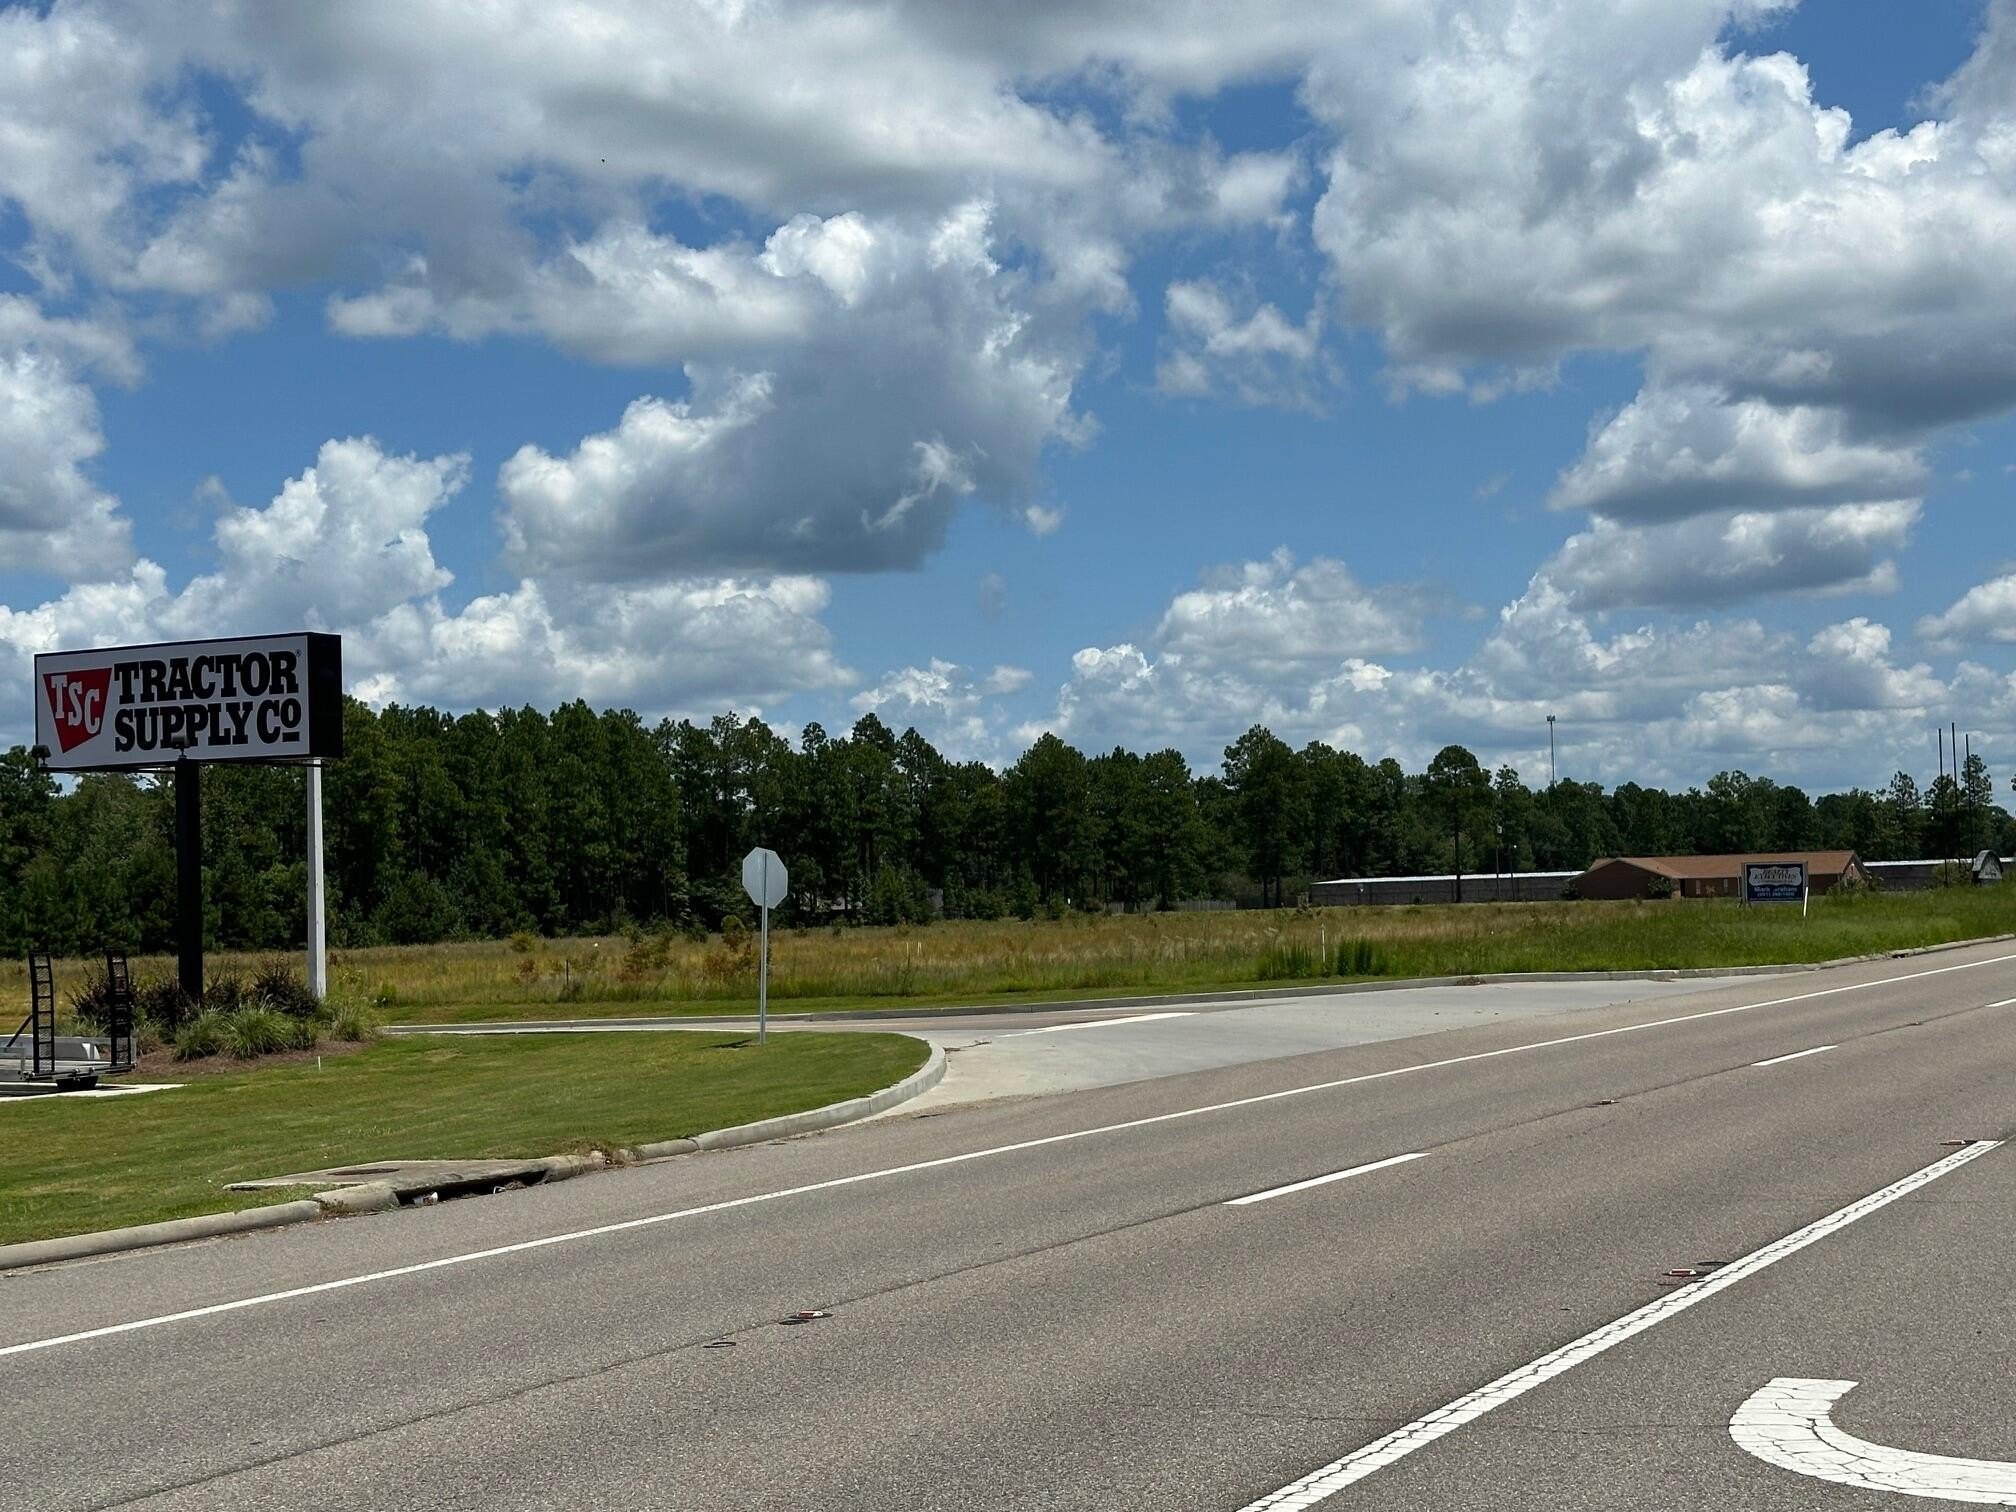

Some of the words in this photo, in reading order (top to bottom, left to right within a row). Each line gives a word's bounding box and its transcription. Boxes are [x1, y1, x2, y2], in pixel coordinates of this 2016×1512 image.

[114, 650, 299, 704] TRACTOR
[51, 675, 100, 734] TSC
[114, 701, 253, 752] SUPPLY
